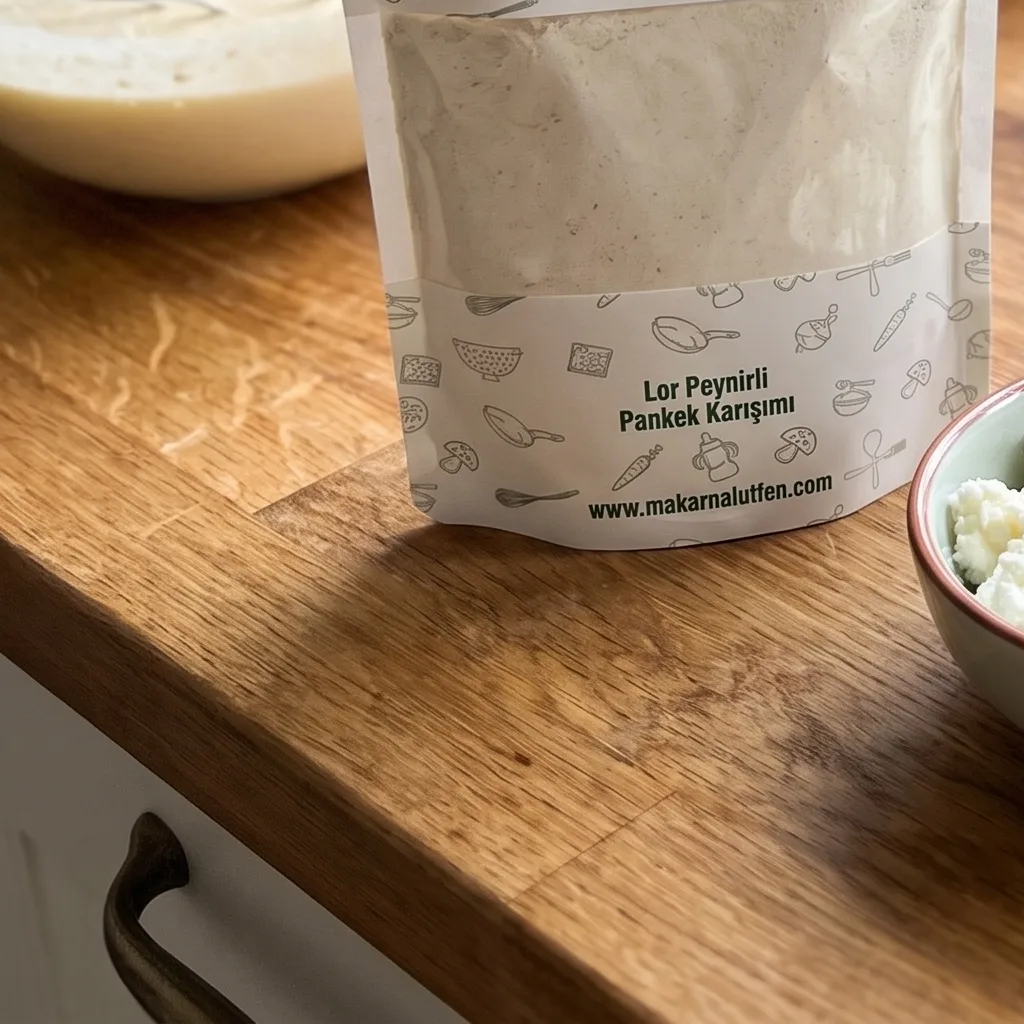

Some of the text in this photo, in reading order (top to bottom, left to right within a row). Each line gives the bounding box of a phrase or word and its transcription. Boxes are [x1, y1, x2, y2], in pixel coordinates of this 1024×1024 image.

[643, 367, 769, 403] Lor Peynirli
[619, 395, 796, 433] Pankek Karışımı
[588, 475, 833, 520] www.makarnalutfen.com
